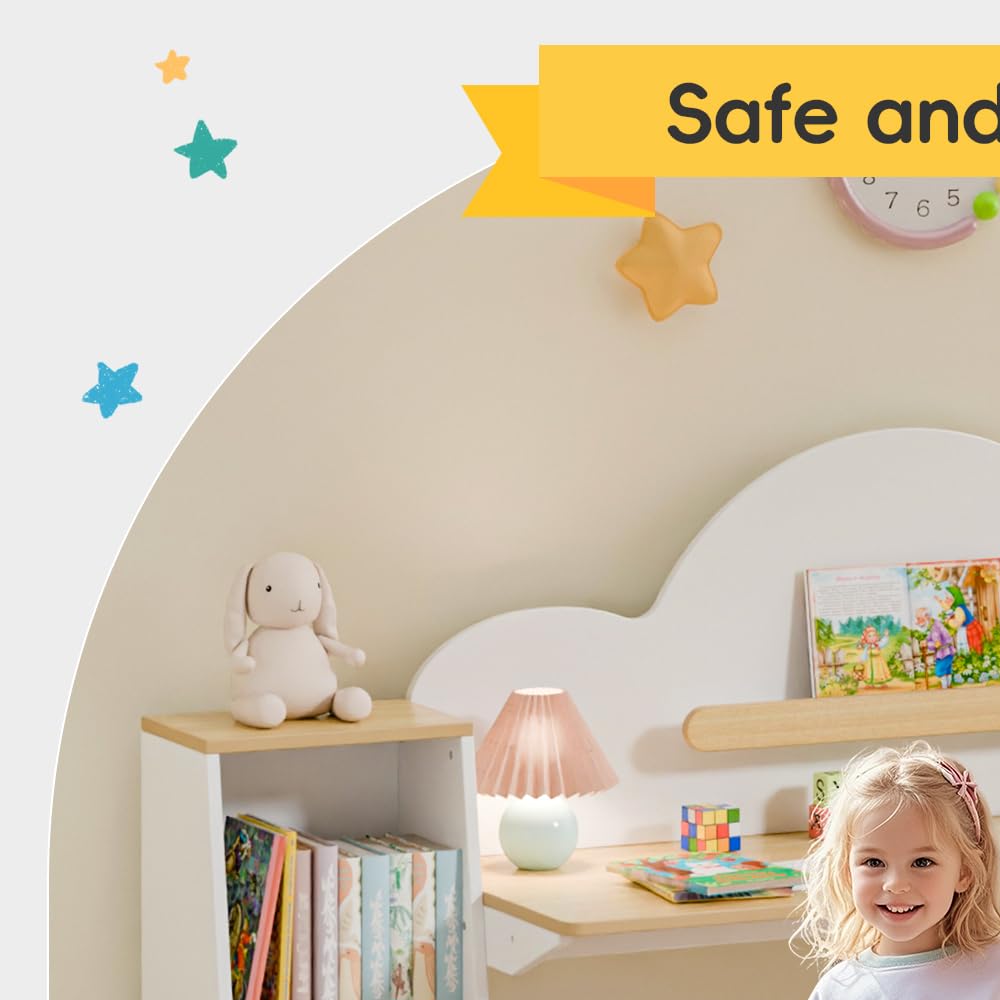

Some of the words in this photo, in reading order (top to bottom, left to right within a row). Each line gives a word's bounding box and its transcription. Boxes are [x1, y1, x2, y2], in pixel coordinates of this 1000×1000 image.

[884, 191, 899, 210] 7
[947, 188, 960, 207] 5
[916, 199, 930, 218] 6
